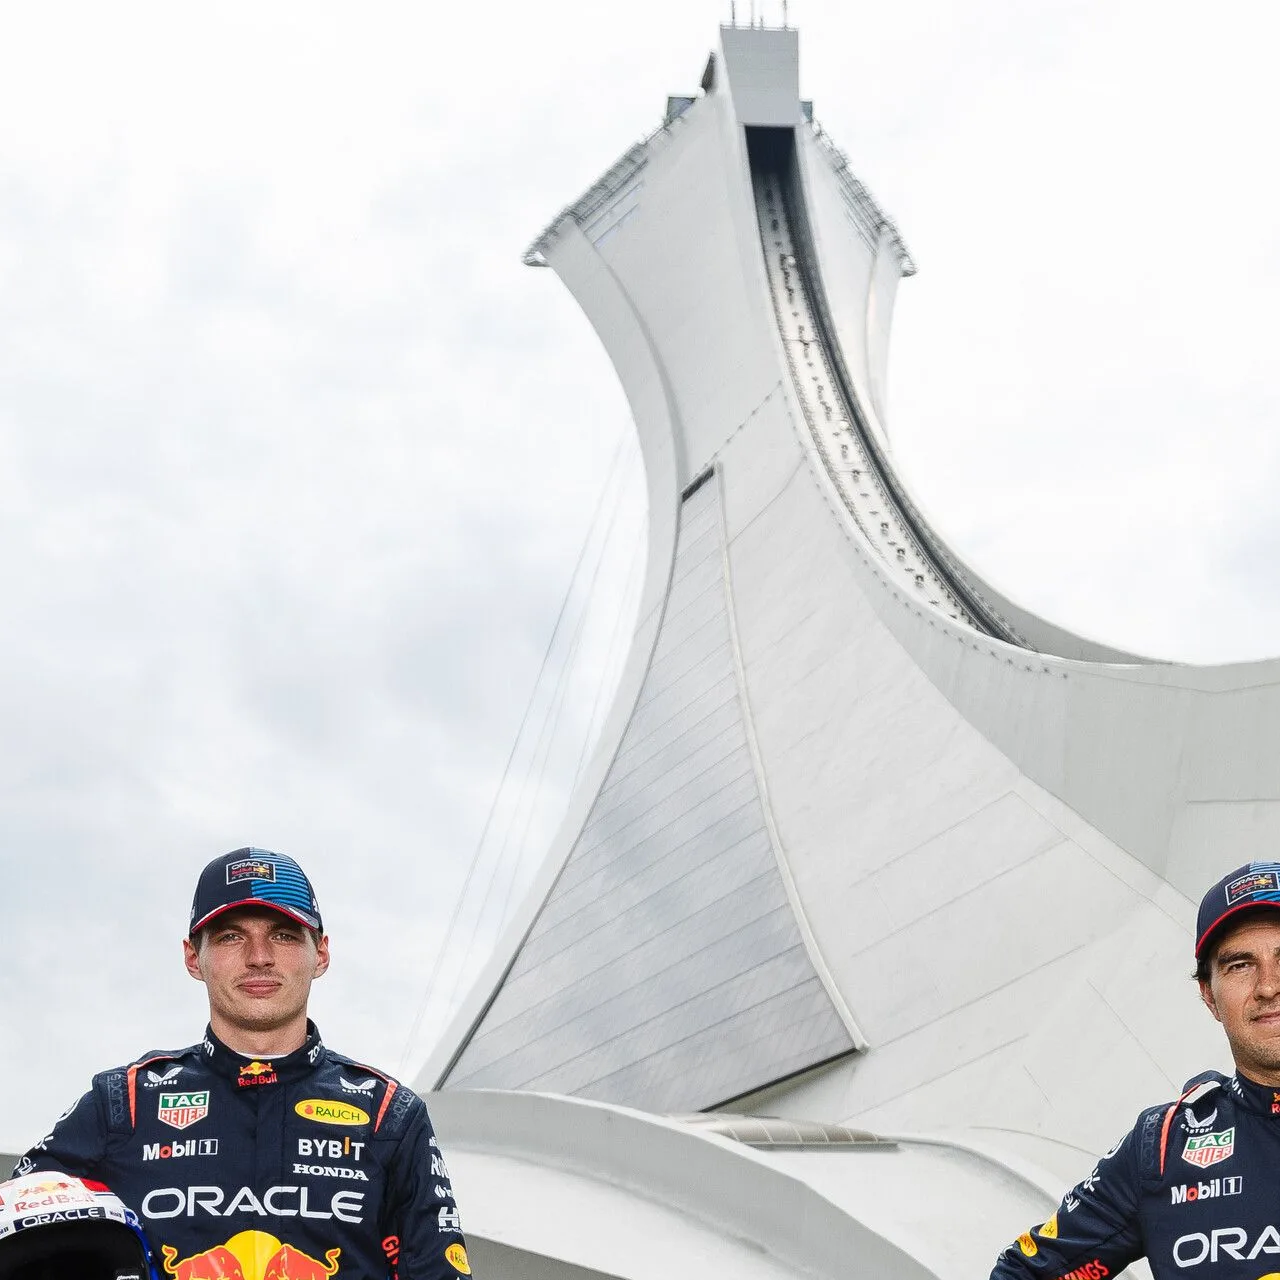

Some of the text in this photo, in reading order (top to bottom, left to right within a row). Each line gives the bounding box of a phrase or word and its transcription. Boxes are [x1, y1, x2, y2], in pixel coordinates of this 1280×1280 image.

[231, 861, 269, 870] ORACLE
[1230, 873, 1272, 889] ORACLE
[237, 1073, 277, 1087] Red Bull
[163, 1094, 205, 1108] TAG
[161, 1108, 207, 1127] HEUER
[316, 1106, 360, 1121] RAUCH
[298, 1136, 365, 1161] BYBIT
[1189, 1132, 1232, 1147] TAG
[142, 1139, 196, 1161] Mobil
[1184, 1147, 1232, 1165] HEUER
[292, 1163, 369, 1181] HONDA
[1171, 1179, 1220, 1204] Mobil
[15, 1195, 55, 1213] Red
[141, 1186, 365, 1223] ORACLE
[22, 1207, 100, 1228] ORACLE
